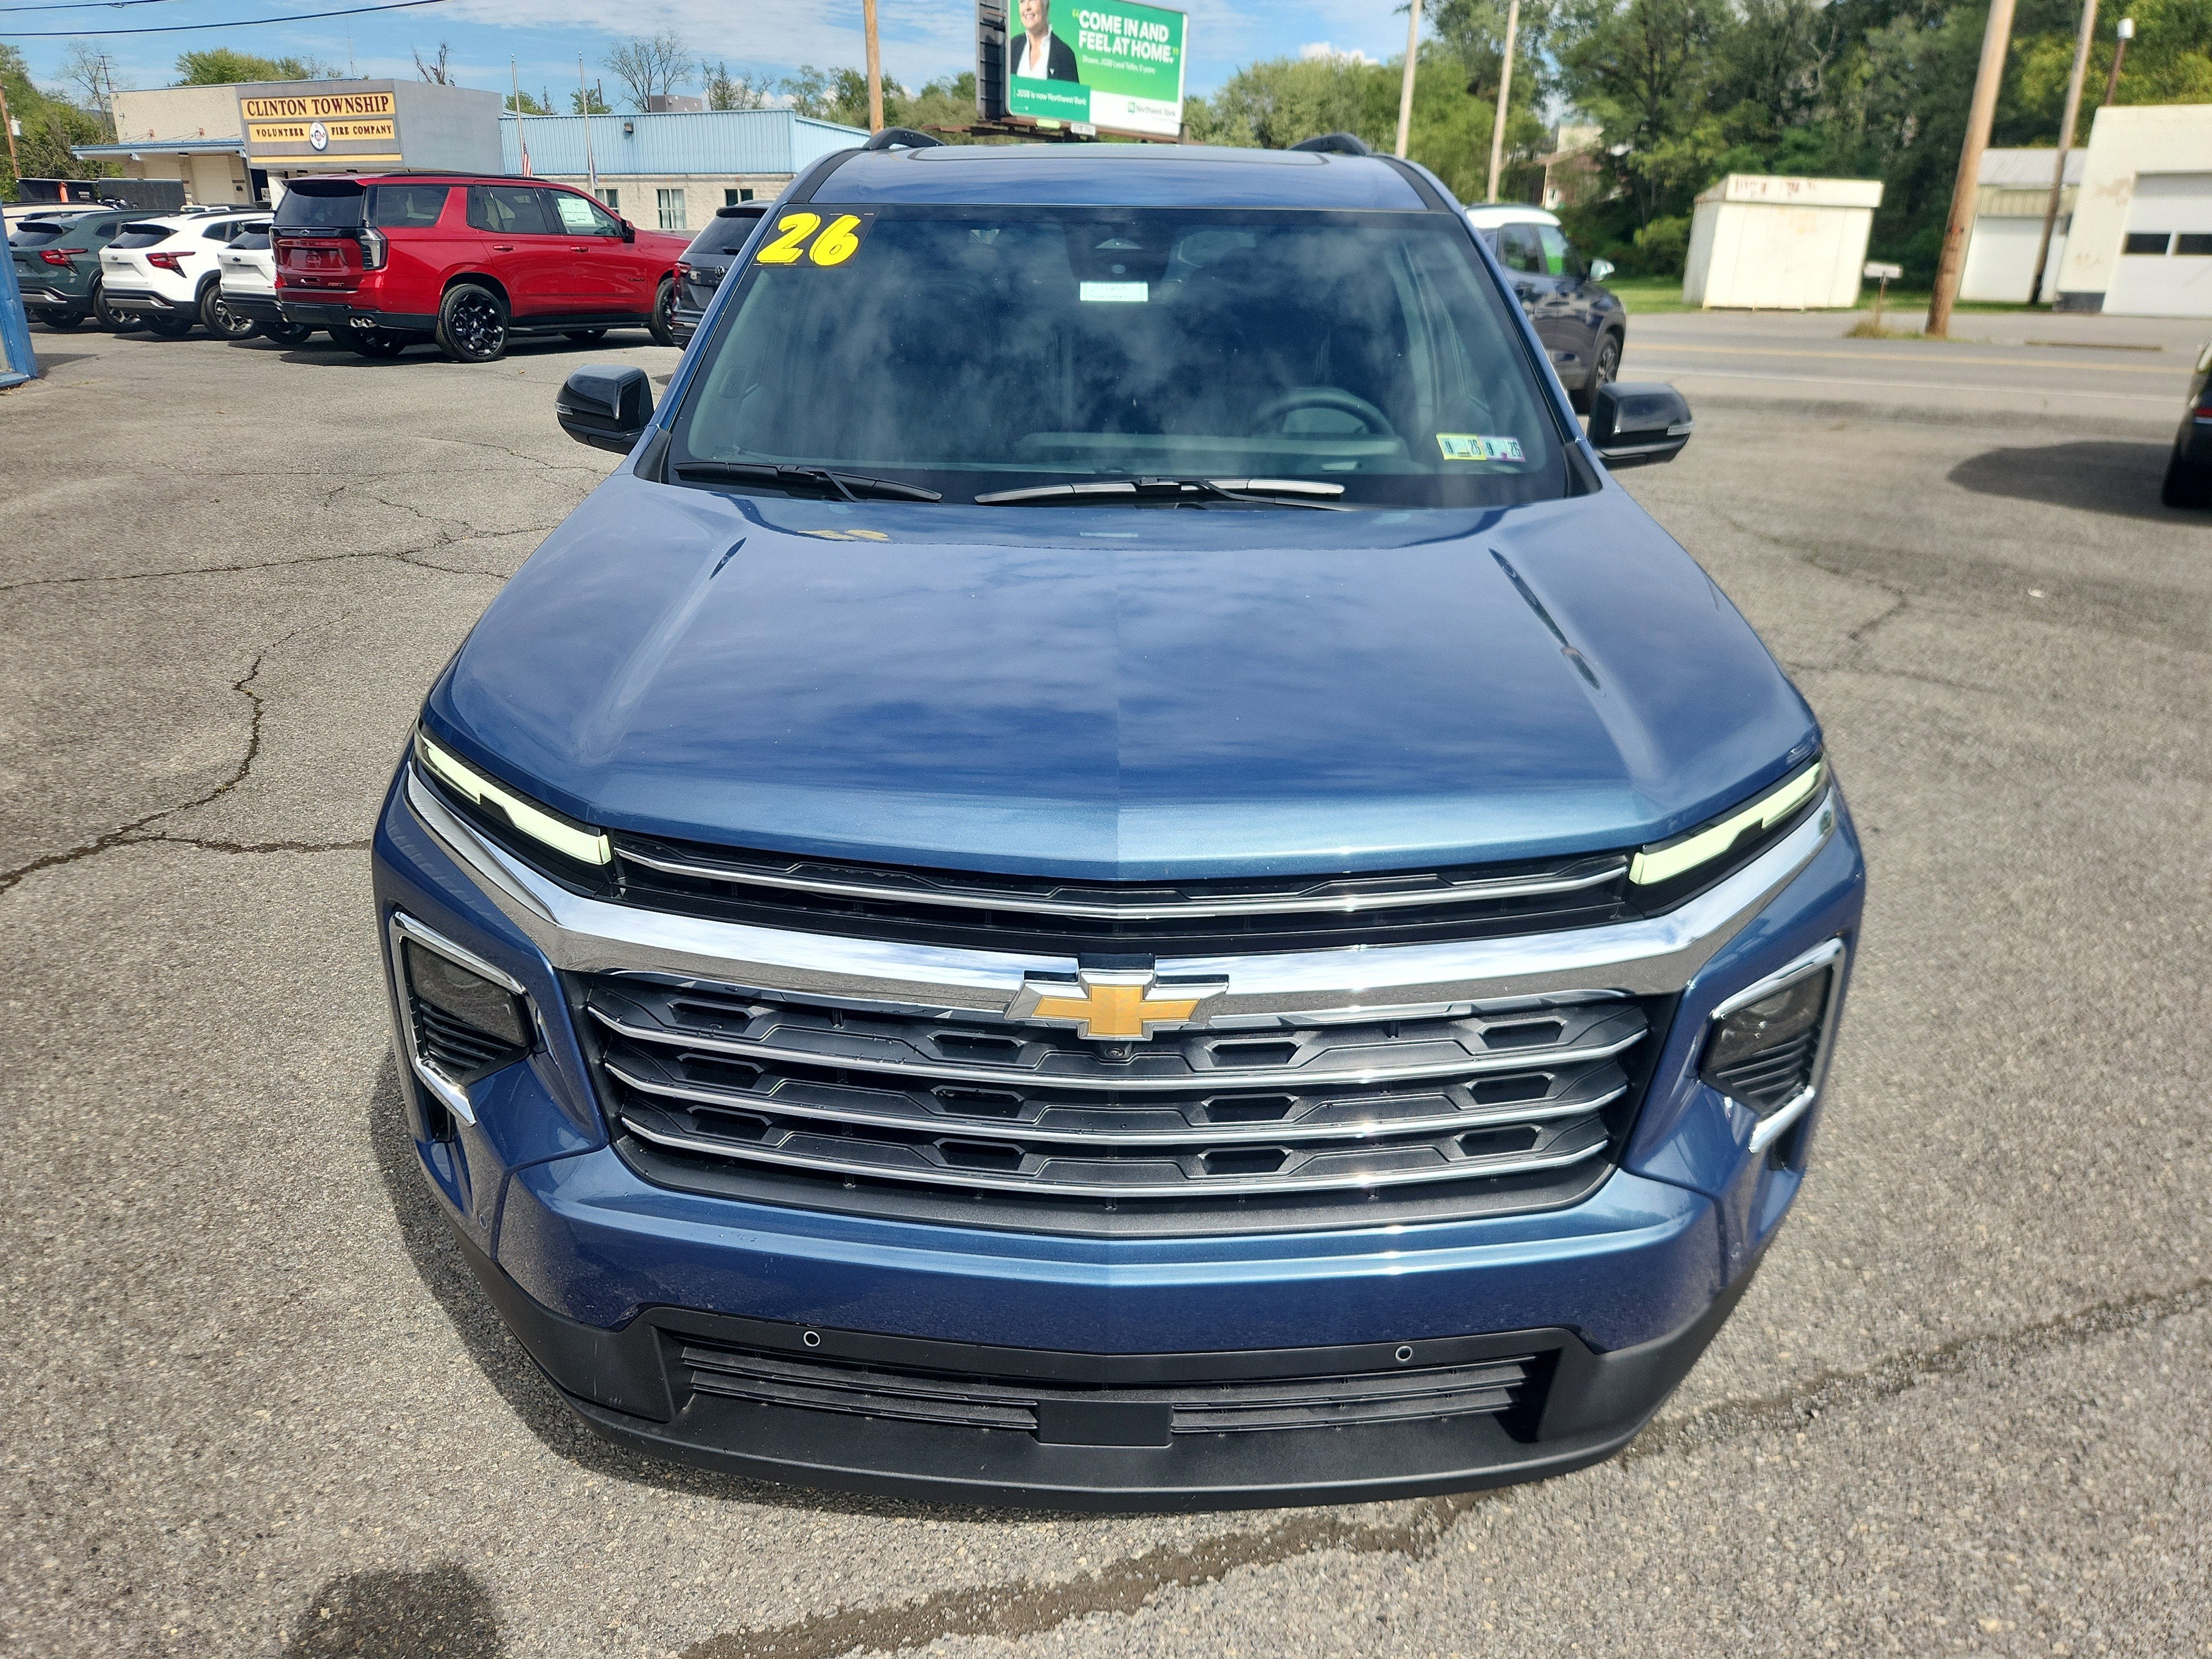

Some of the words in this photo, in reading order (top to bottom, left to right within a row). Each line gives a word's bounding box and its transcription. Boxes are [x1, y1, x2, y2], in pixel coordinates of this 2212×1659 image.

[1123, 17, 1139, 38] IN
[1139, 21, 1169, 43] AND
[1078, 29, 1111, 53] FEEL
[1111, 36, 1130, 56] AT
[247, 99, 307, 116] CLINTON
[311, 95, 389, 115] TOWNSHIP
[1136, 105, 1162, 115] Northwest
[1163, 108, 1176, 117] Bank
[256, 128, 305, 137] VOLUNTEER
[331, 126, 350, 136] FIRE
[353, 125, 392, 134] COMPANY
[756, 212, 861, 266] 26
[1444, 440, 1454, 455] 9
[1468, 440, 1482, 455] 26
[1485, 442, 1495, 456] 9
[1507, 441, 1522, 457] 26
